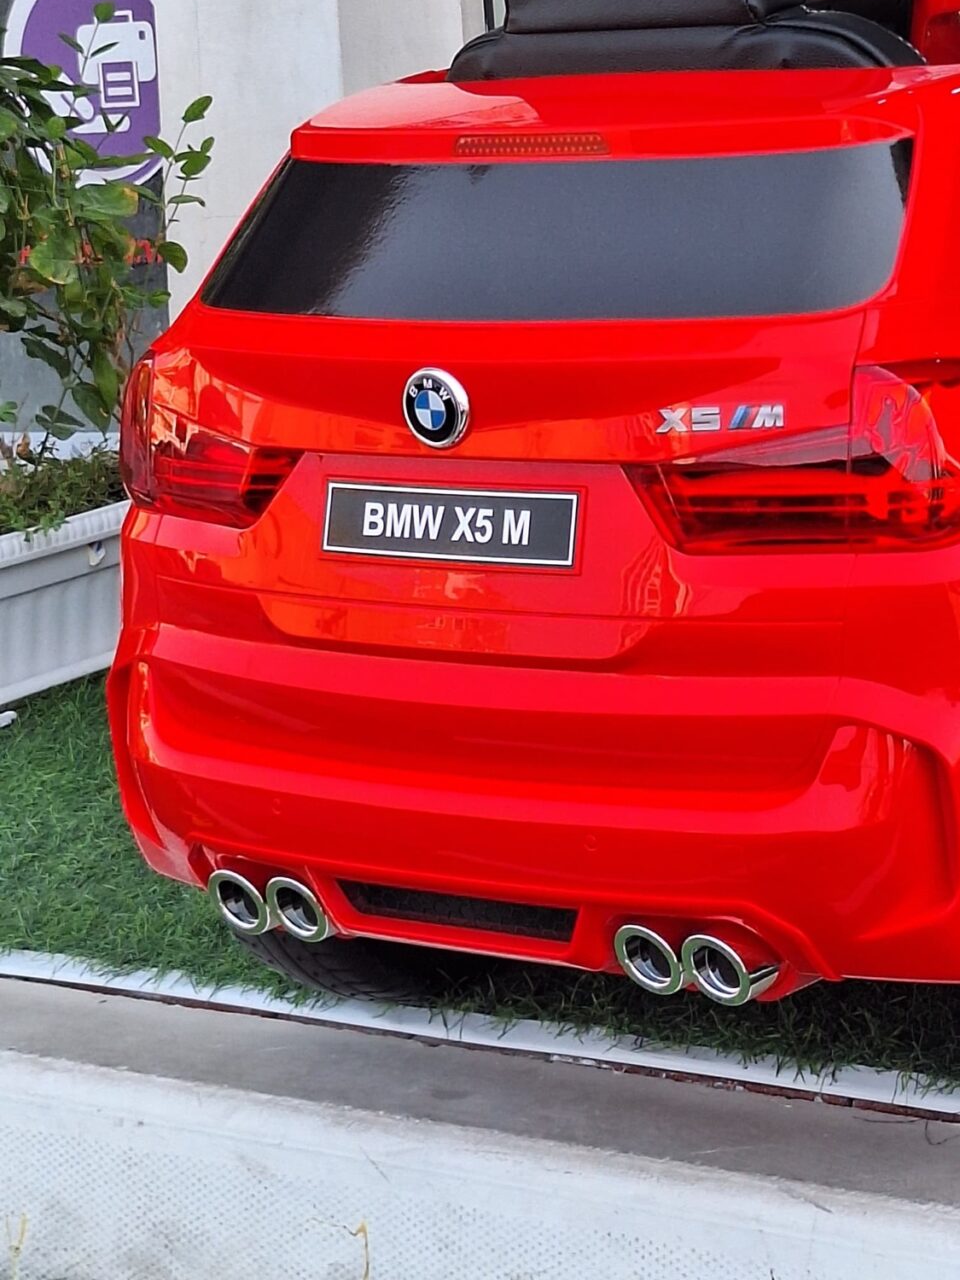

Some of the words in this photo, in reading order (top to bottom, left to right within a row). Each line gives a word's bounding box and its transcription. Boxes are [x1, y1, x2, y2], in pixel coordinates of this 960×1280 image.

[408, 377, 452, 402] BMW
[656, 406, 721, 434] X5
[361, 502, 444, 541] BMW
[452, 505, 494, 546] X5
[500, 508, 531, 546] M
